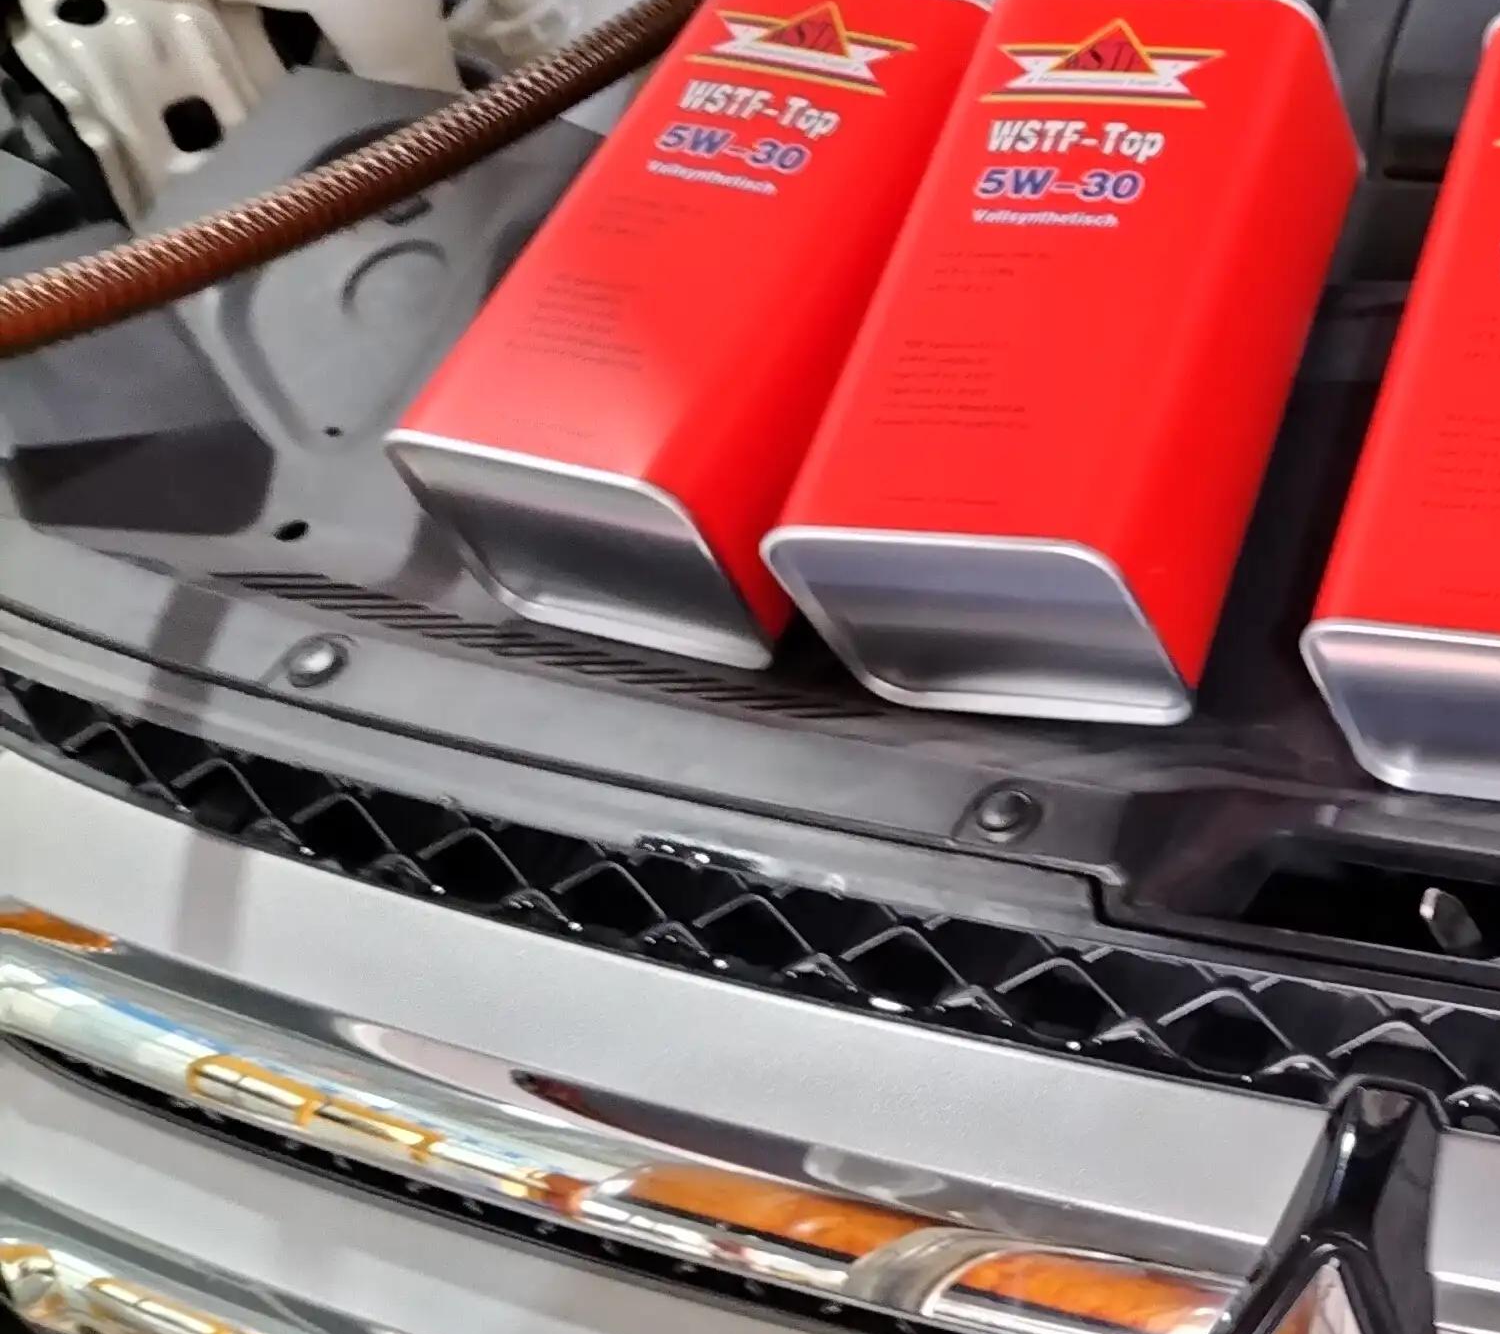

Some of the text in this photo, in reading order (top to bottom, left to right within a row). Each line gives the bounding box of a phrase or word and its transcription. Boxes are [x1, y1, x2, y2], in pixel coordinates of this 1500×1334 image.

[677, 79, 841, 139] WSTF-Top
[655, 121, 812, 173] 5W-30
[987, 119, 1166, 163] WSTF-Top
[973, 166, 1146, 201] 5W-30
